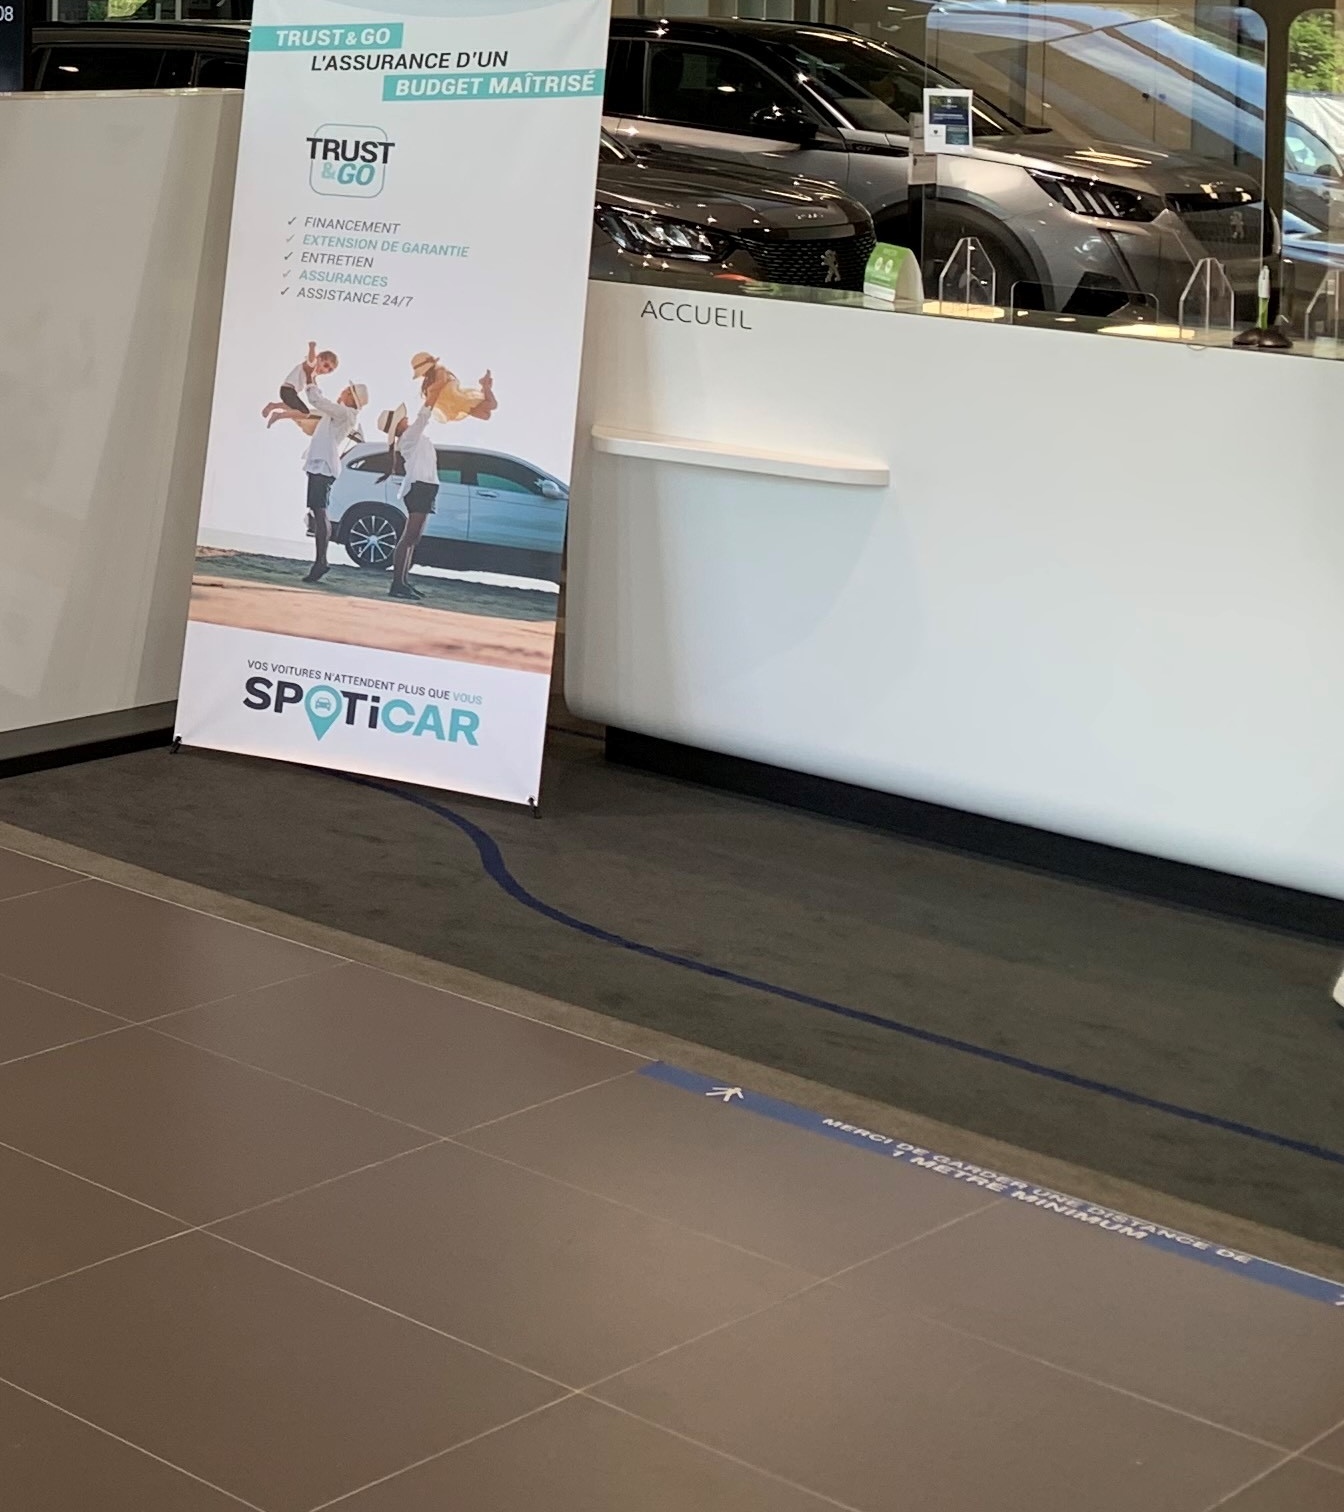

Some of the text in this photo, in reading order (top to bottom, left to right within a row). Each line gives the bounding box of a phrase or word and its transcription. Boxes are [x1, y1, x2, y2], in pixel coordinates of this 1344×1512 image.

[311, 50, 509, 71] L'ASSURANCE D'UN
[395, 70, 597, 96] BUDGET MAÎTRISÉ
[306, 137, 395, 164] TRUST
[304, 216, 401, 235] FINANCEMENT
[302, 234, 470, 258] EXTENSION DE GARANTIE
[300, 251, 374, 268] ENTRETIEN
[298, 269, 389, 288] ASSURANCES
[296, 287, 414, 308] ASSISTANCE 24/7
[640, 299, 752, 330] ACCUEIL
[247, 659, 483, 705] VOS VOITURES N'ATTENDENT PLUS QUE VOUS
[822, 1118, 1253, 1265] MERCI DE GARDER UNE DISTANCE DE
[892, 1150, 905, 1158] 1
[1011, 1190, 1149, 1240] MINIMUM
